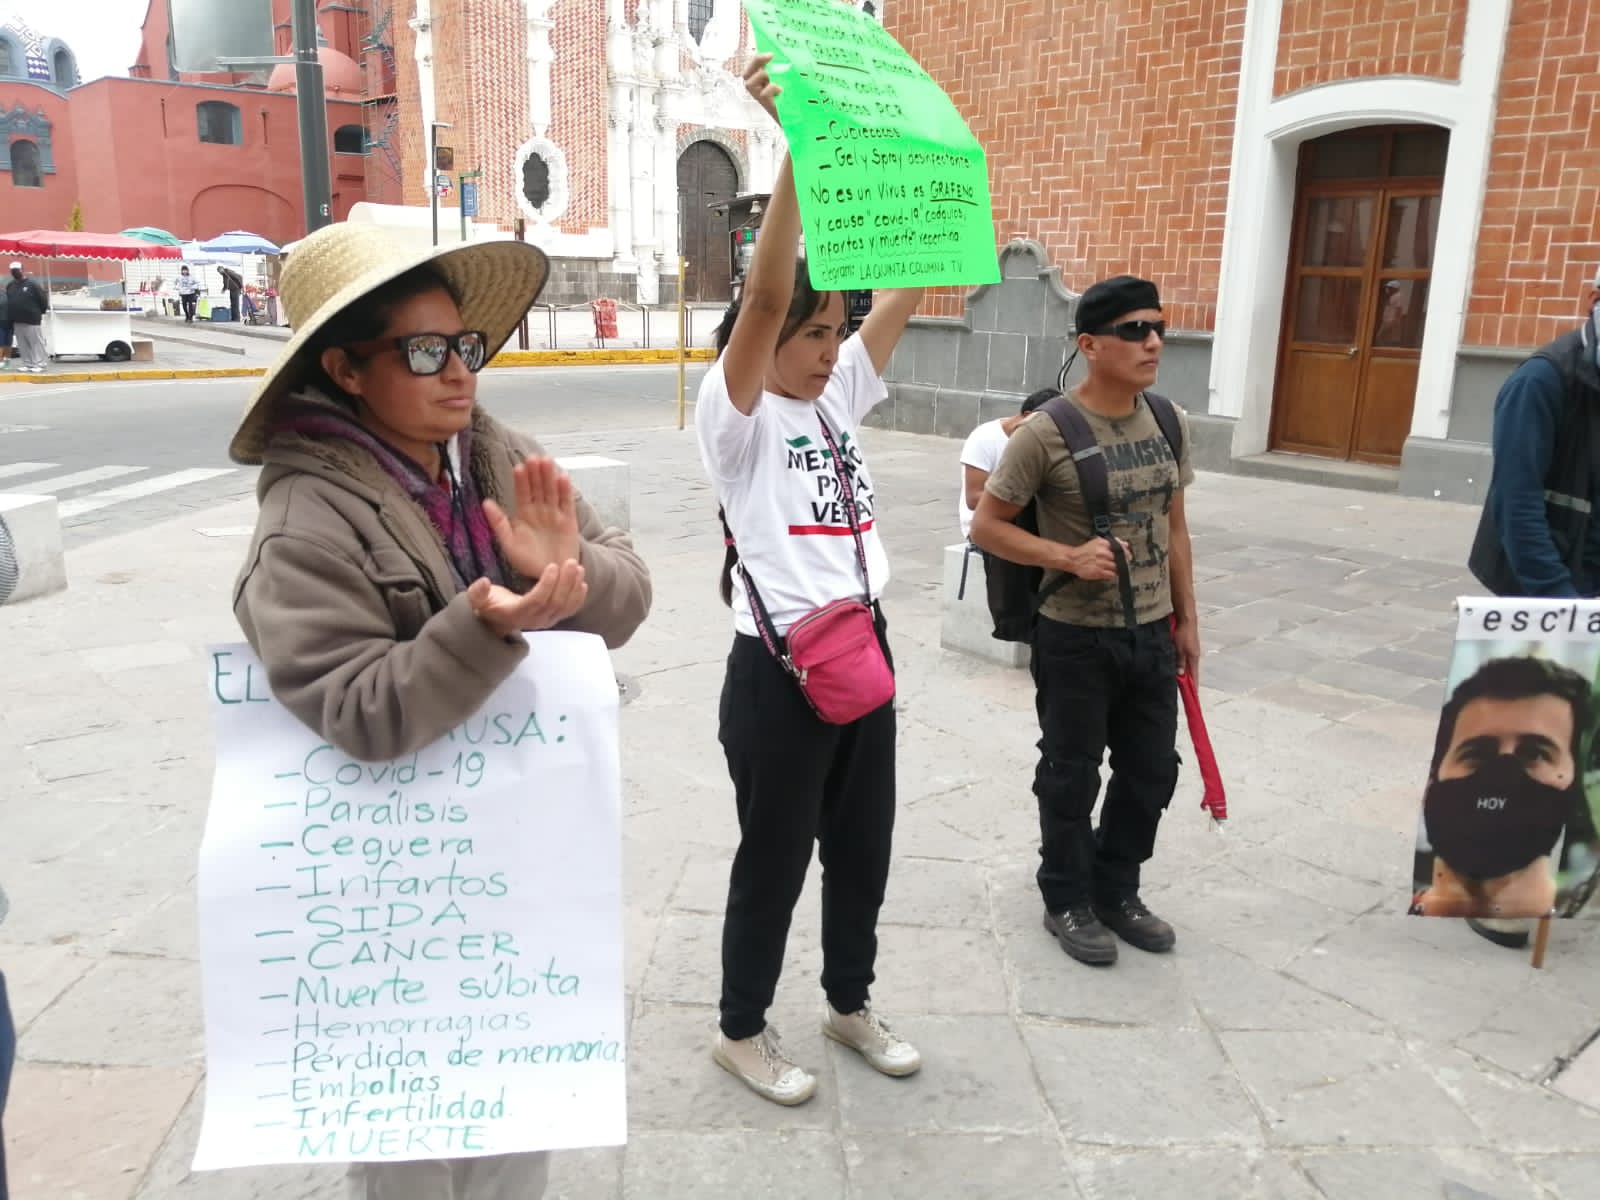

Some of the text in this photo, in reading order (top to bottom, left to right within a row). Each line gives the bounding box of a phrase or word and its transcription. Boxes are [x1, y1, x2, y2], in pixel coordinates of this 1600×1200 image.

[810, 179, 830, 204] No
[836, 188, 853, 203] es
[857, 187, 871, 200] un
[913, 185, 925, 197] es
[930, 181, 974, 198] GRAFENO
[214, 652, 270, 704] EL
[1477, 797, 1506, 810] HOY
[307, 901, 466, 938] SIDA
[295, 957, 580, 1008] Muerte súbita
[293, 1038, 428, 1073] Pérdida
[447, 1036, 483, 1066] de
